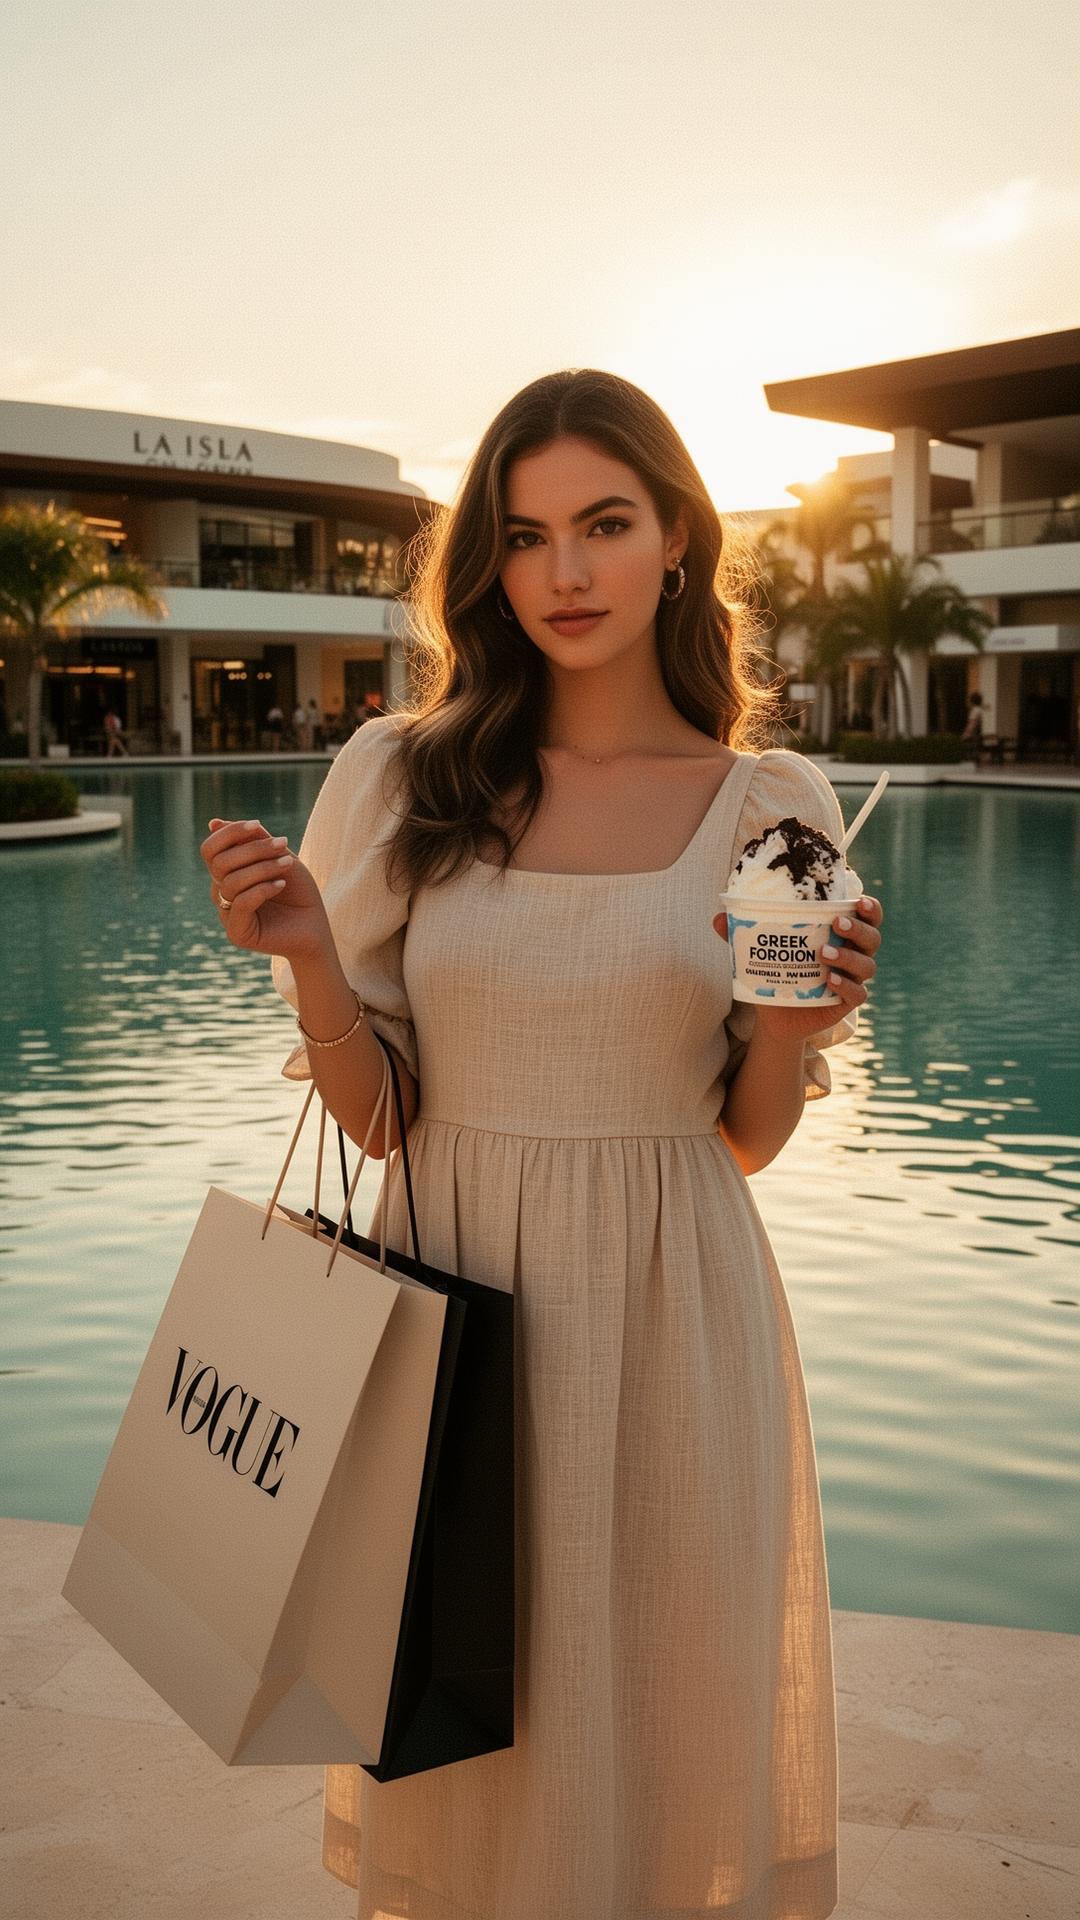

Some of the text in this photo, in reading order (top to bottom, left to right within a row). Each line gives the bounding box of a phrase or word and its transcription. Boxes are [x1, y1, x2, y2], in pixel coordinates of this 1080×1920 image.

[134, 431, 252, 462] LA ISLA
[757, 934, 808, 948] GREEK
[750, 947, 816, 962] FOROION
[166, 1346, 301, 1498] VOGUE
